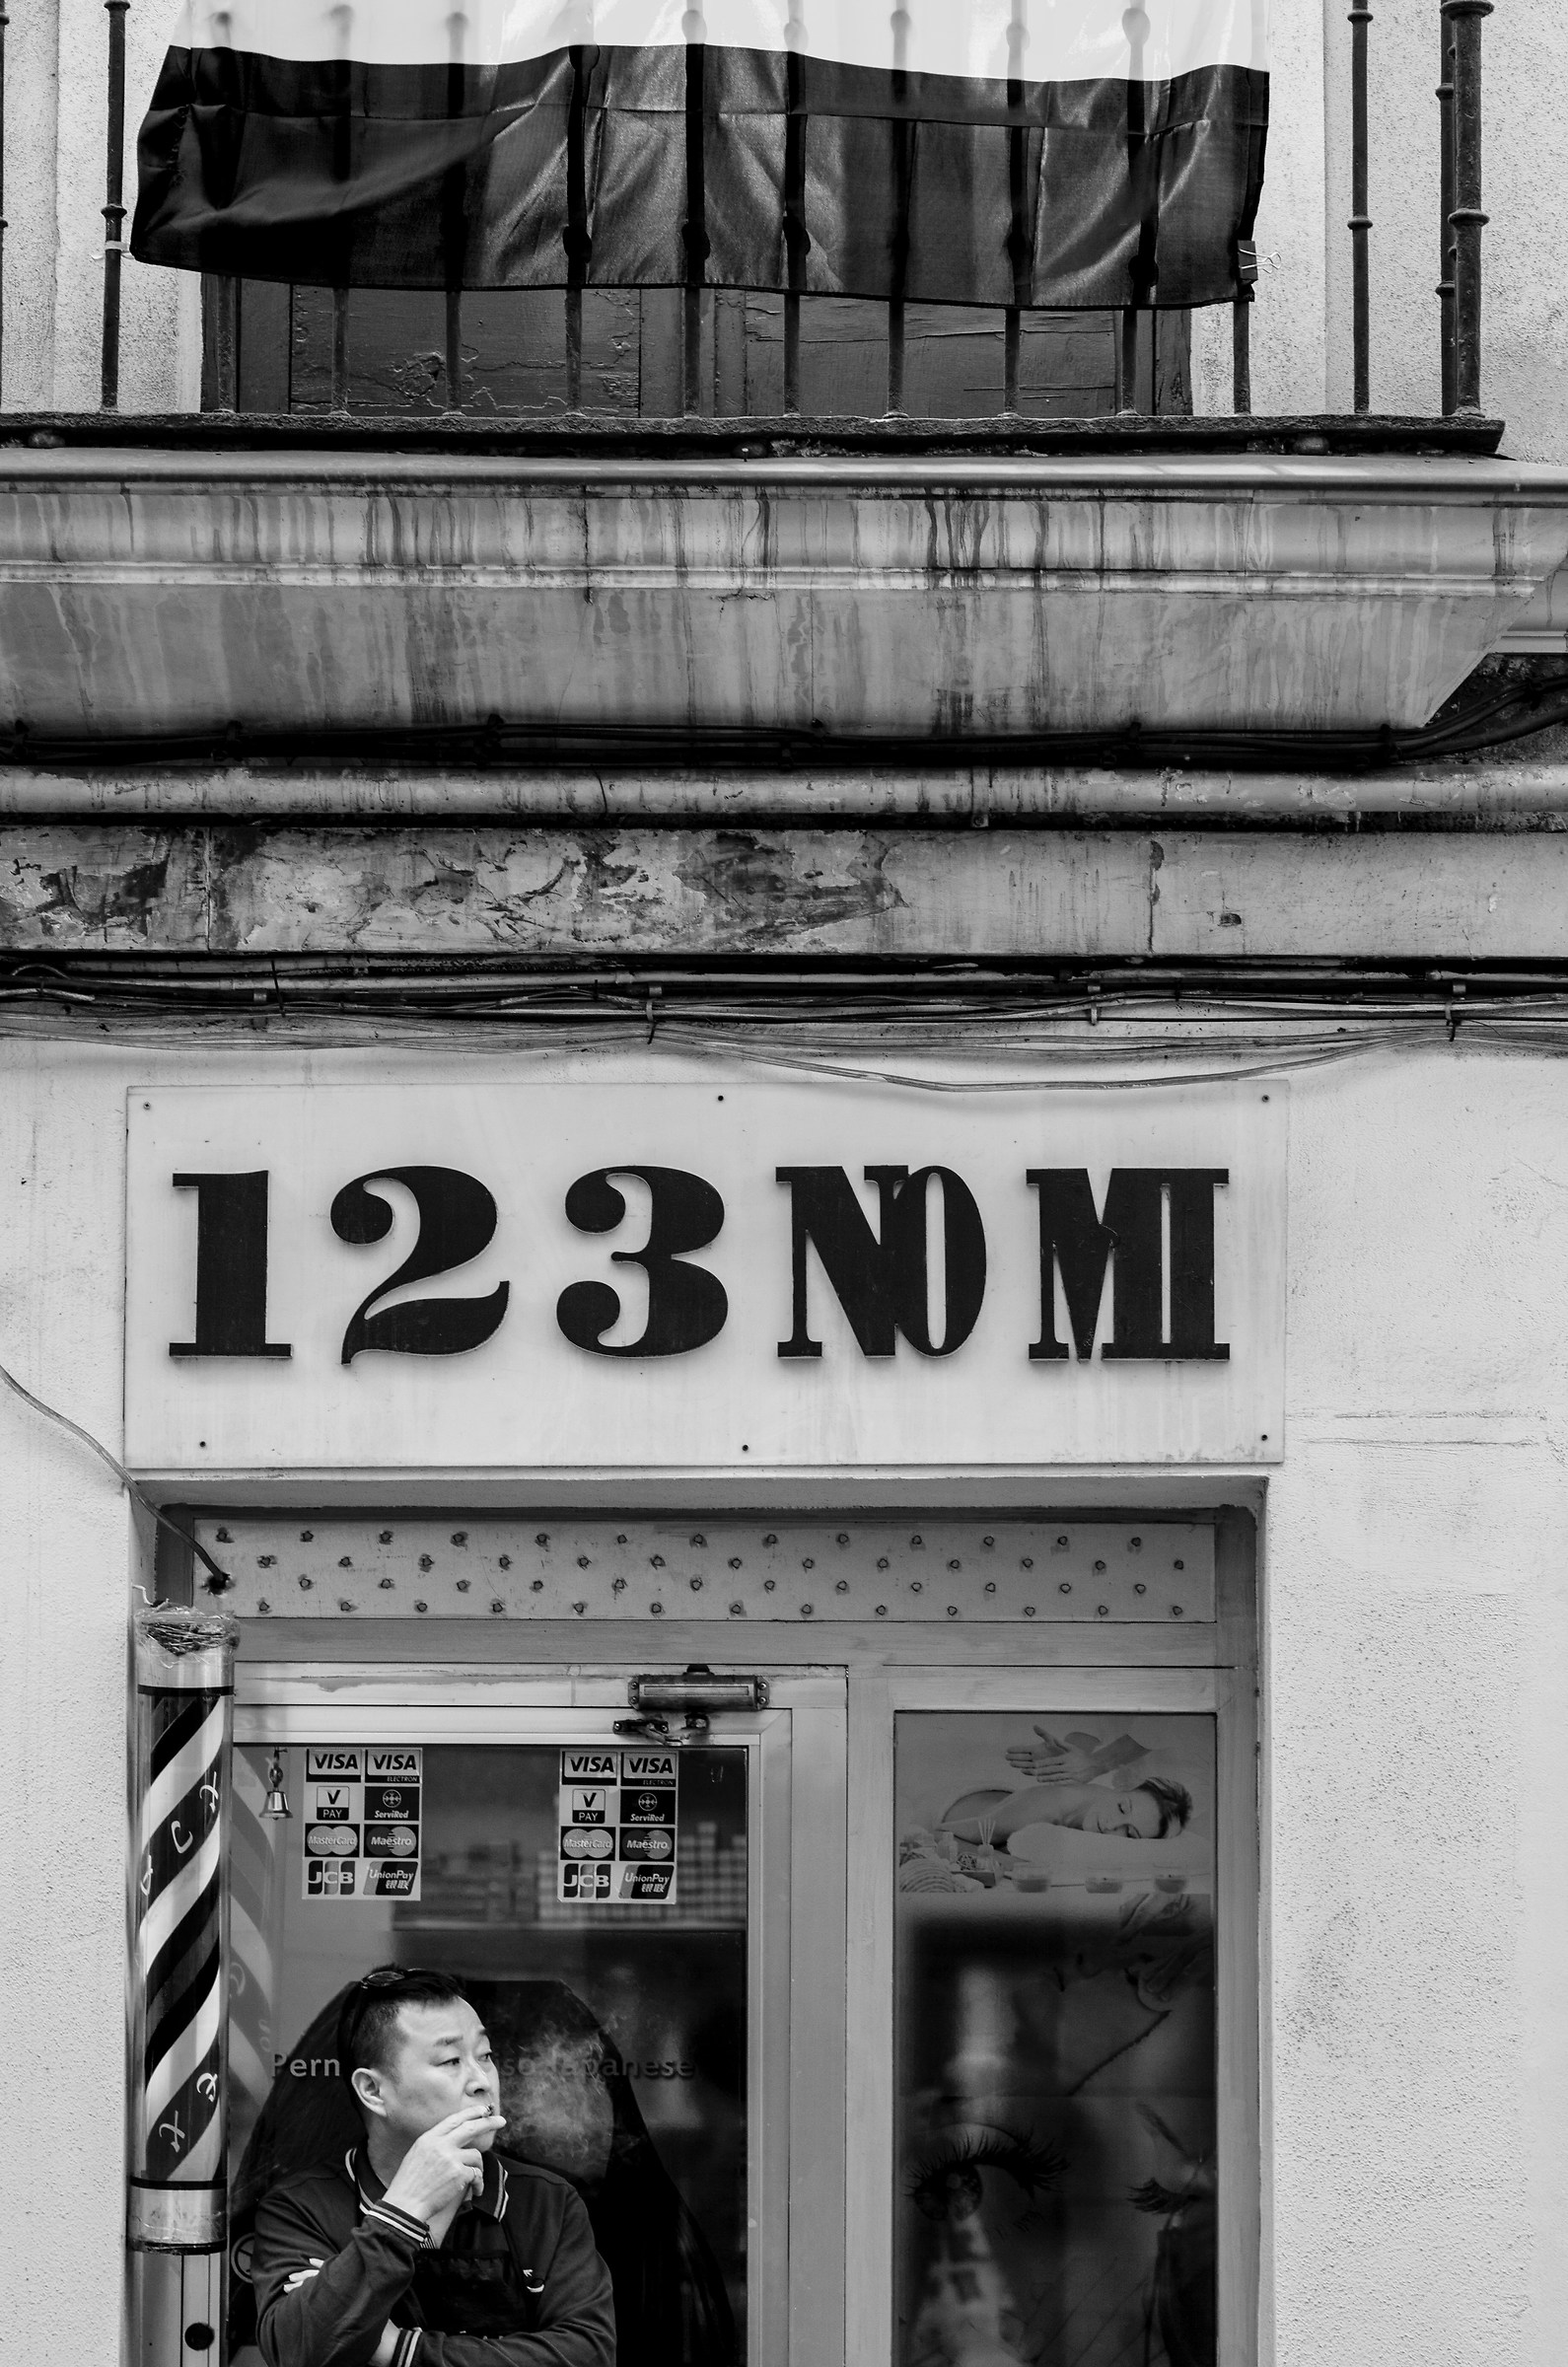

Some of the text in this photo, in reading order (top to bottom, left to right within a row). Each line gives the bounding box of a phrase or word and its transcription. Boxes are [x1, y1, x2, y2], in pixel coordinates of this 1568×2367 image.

[315, 1754, 358, 1769] VISA
[373, 1755, 416, 1770] VISA
[569, 1757, 614, 1772] VISA
[628, 1757, 674, 1773] VISA
[325, 1789, 341, 1805] V
[582, 1792, 598, 1808] V
[322, 1809, 342, 1819] PAY
[374, 1810, 409, 1819] ServiRed
[578, 1812, 599, 1822] PAY
[630, 1813, 666, 1822] ServiRed
[308, 1835, 357, 1845] MasterCard
[371, 1835, 412, 1846] Maestro
[564, 1838, 612, 1849] MasterCard
[626, 1838, 669, 1849] Maestro
[308, 1871, 354, 1885] JCB
[369, 1869, 414, 1881] UnionPay
[564, 1874, 610, 1888] JCB
[624, 1872, 670, 1885] UnionPay
